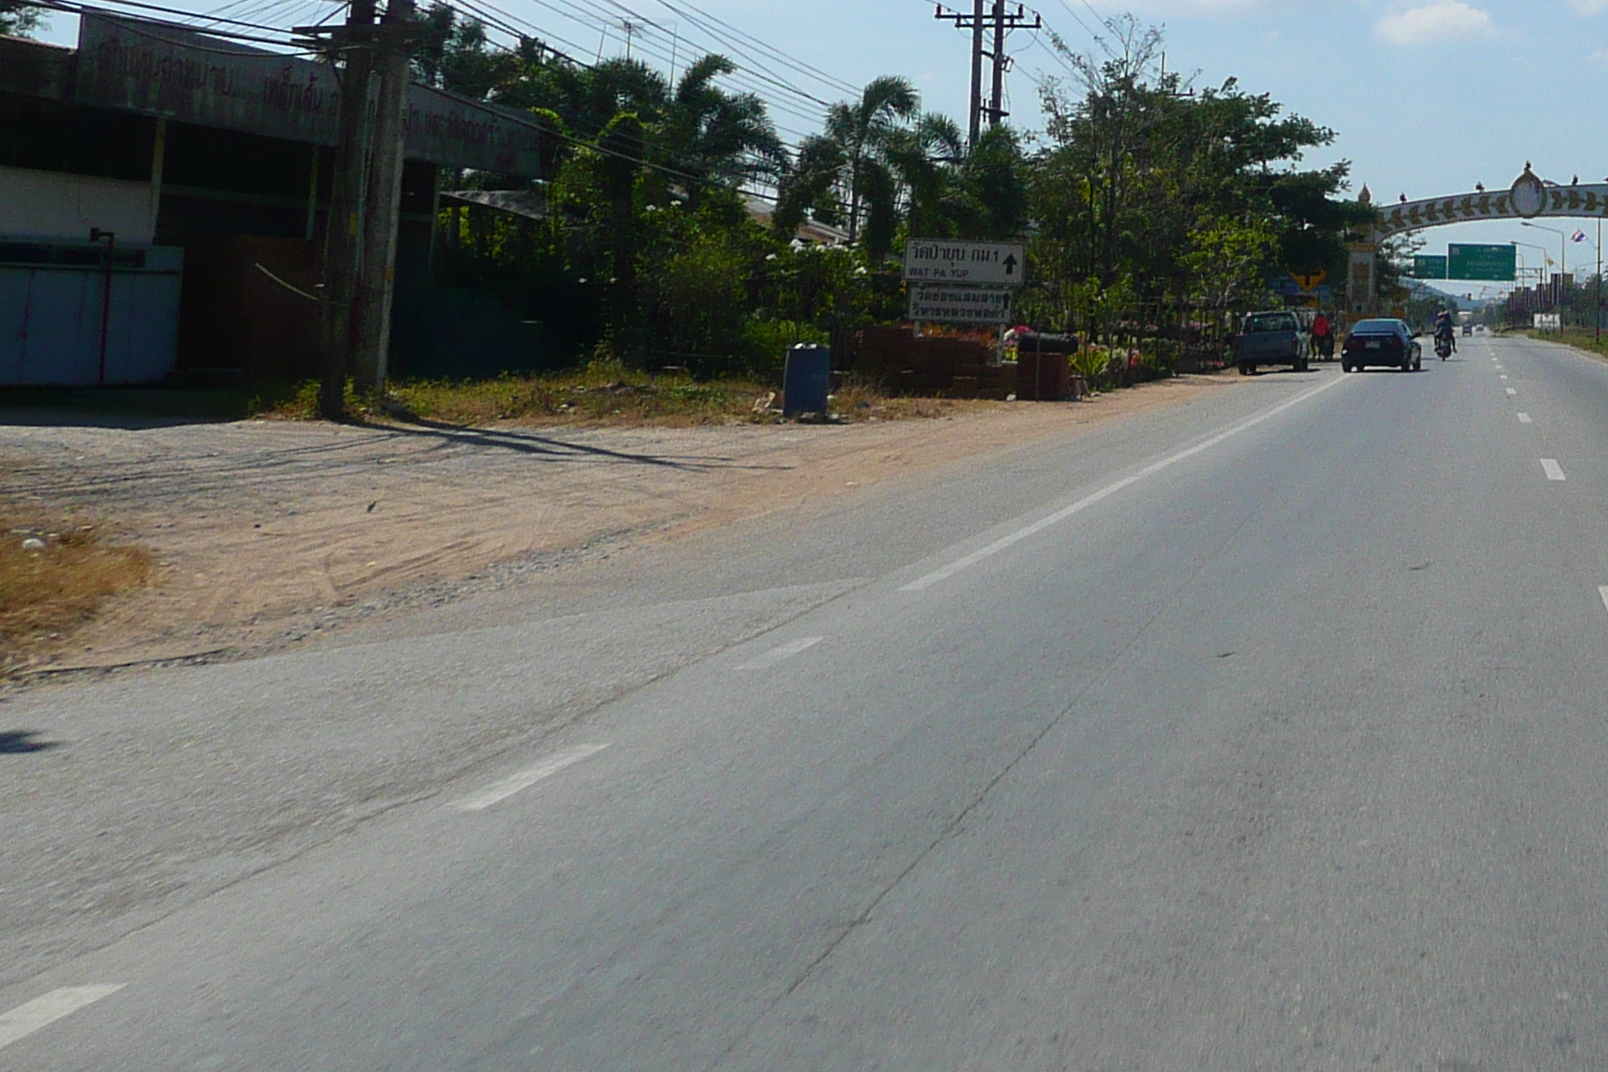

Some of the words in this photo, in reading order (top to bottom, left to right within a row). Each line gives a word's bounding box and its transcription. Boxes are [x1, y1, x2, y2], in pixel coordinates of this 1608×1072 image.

[910, 242, 966, 267] วัดป่ายุบ
[909, 267, 929, 277] WAT
[933, 268, 946, 277] PA
[951, 269, 969, 279] YUP
